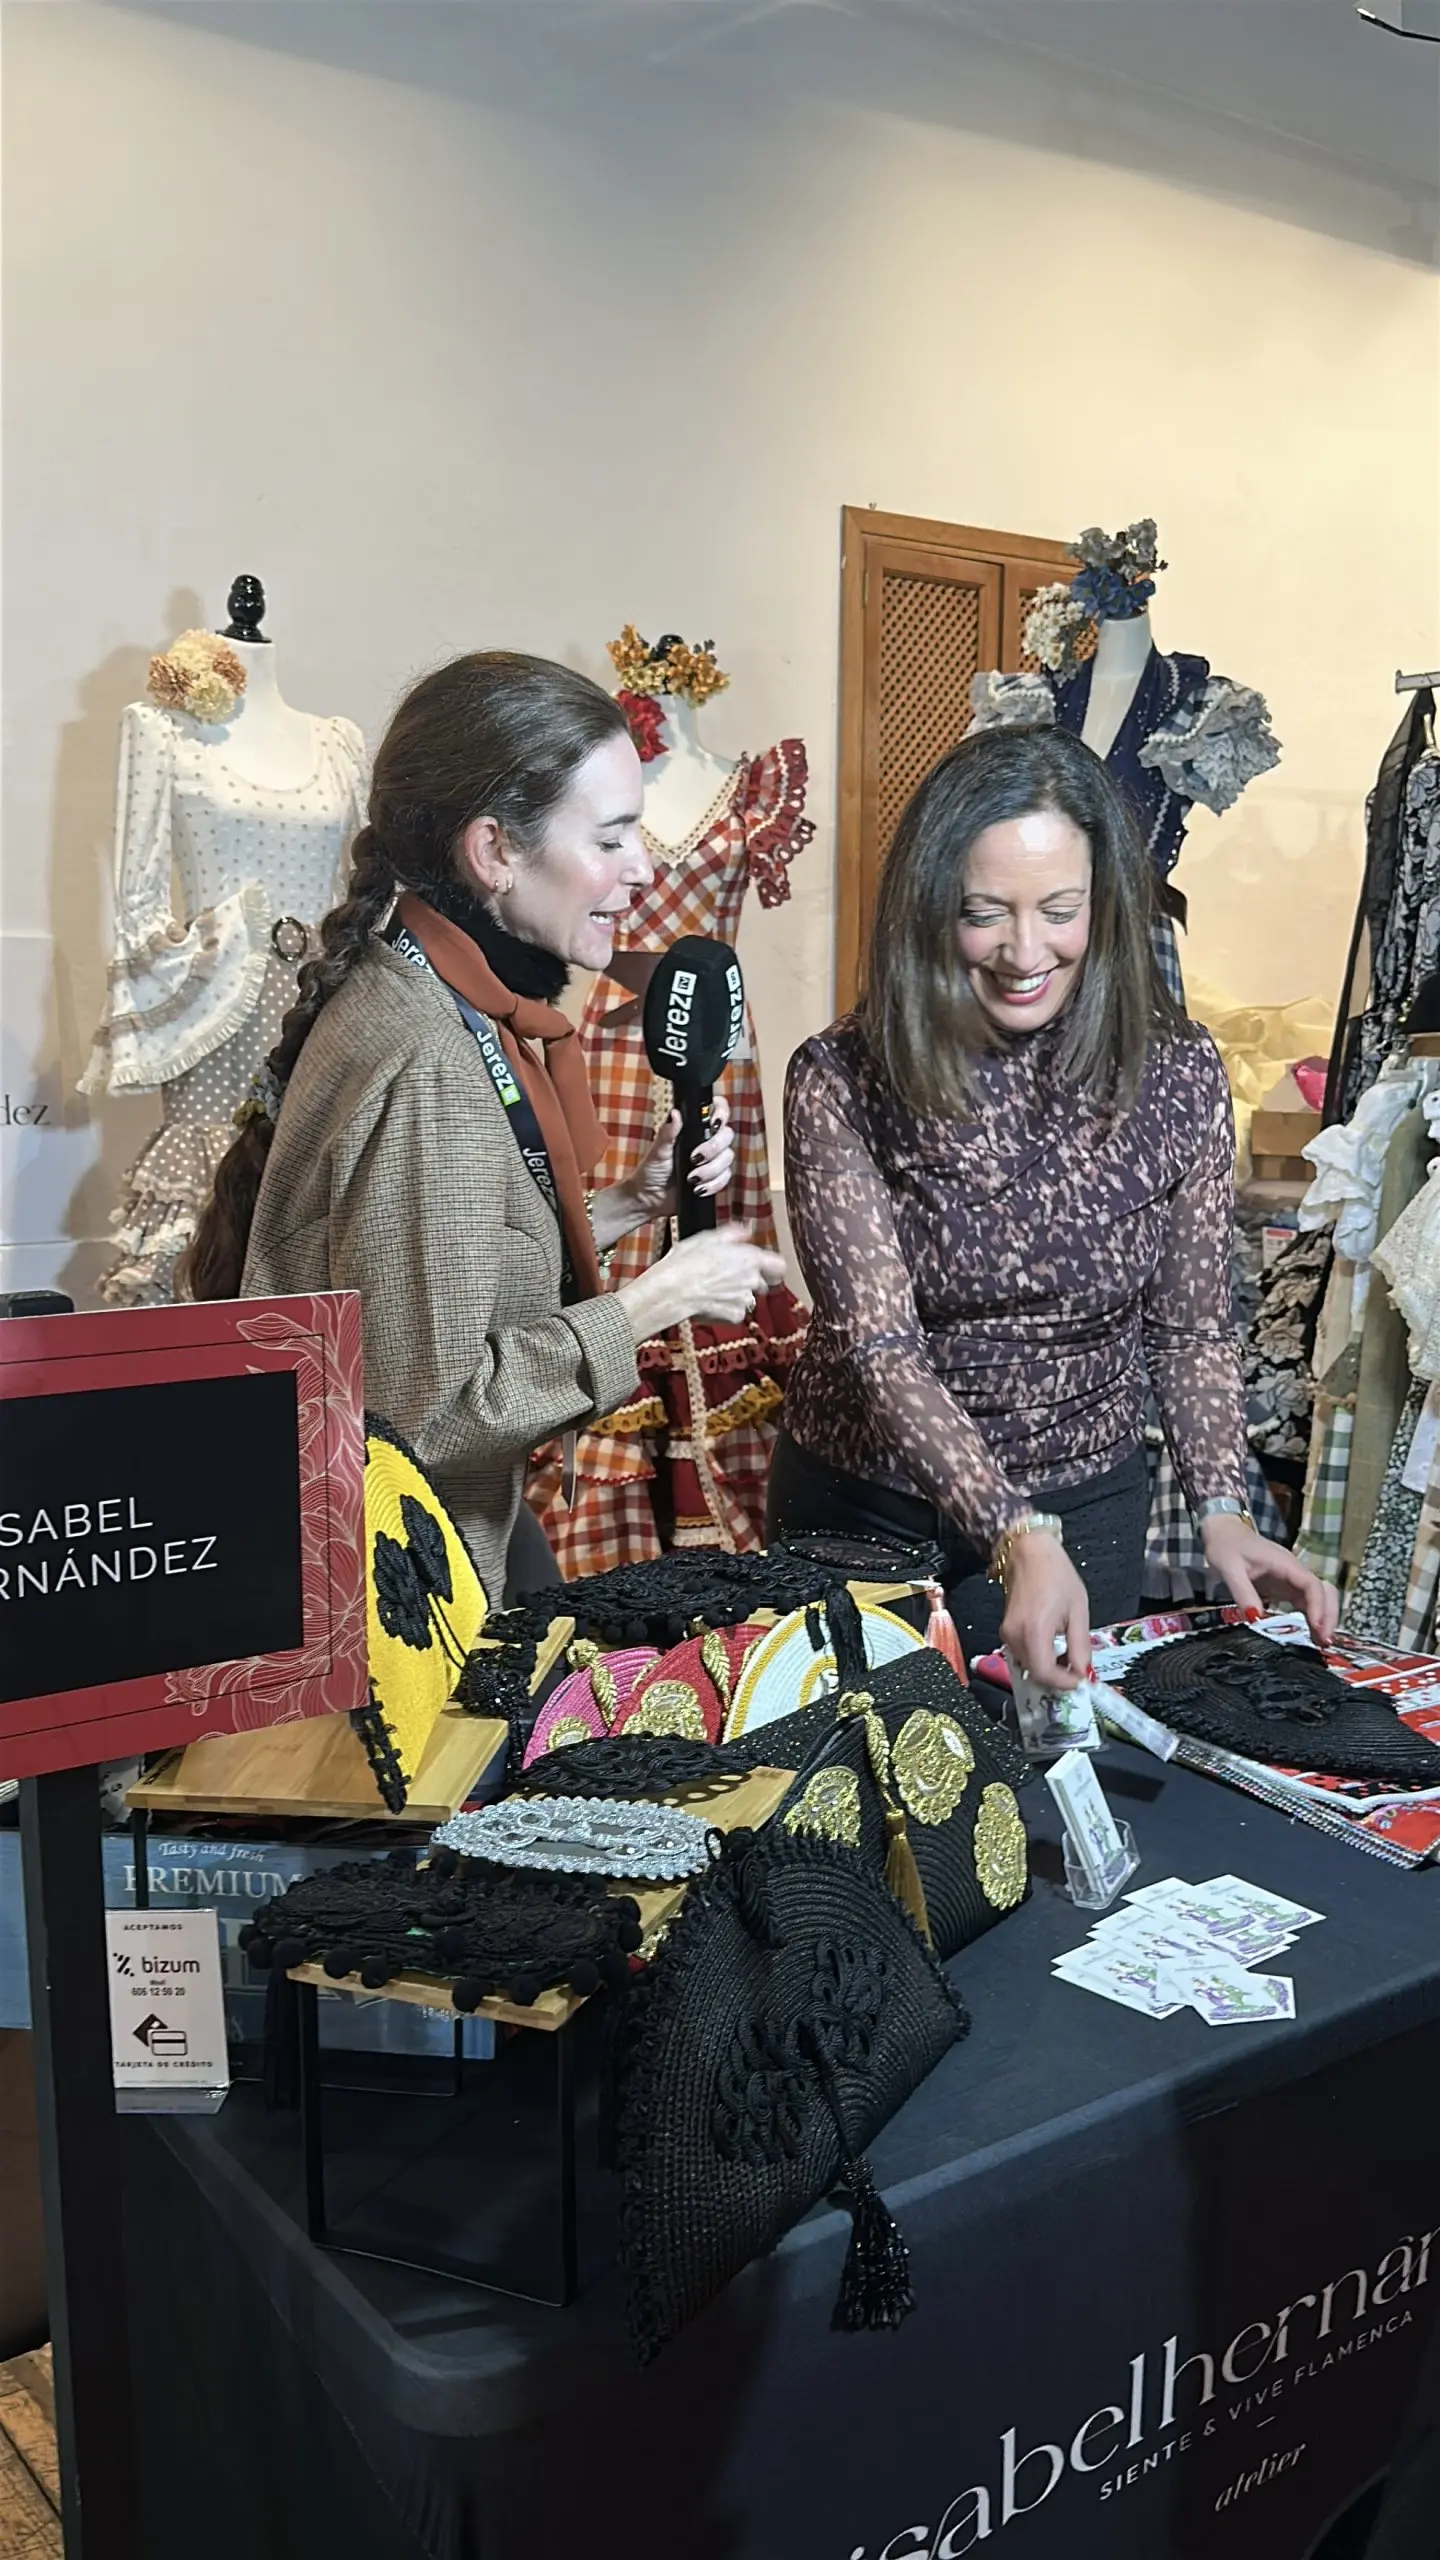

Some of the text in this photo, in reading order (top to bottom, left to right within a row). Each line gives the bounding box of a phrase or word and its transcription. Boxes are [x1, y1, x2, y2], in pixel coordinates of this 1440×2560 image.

[658, 993, 693, 1067] Jerez
[476, 1030, 515, 1091] Jerez
[0, 1497, 153, 1547] SABEL
[158, 1841, 264, 1863] Tasty and fresh
[123, 1923, 184, 1931] ACEPTAMOS
[142, 1956, 201, 1974] bizum
[1100, 2310, 1413, 2501] SIENTE & VIVE FLAMENCA
[1215, 2443, 1306, 2512] atelier
